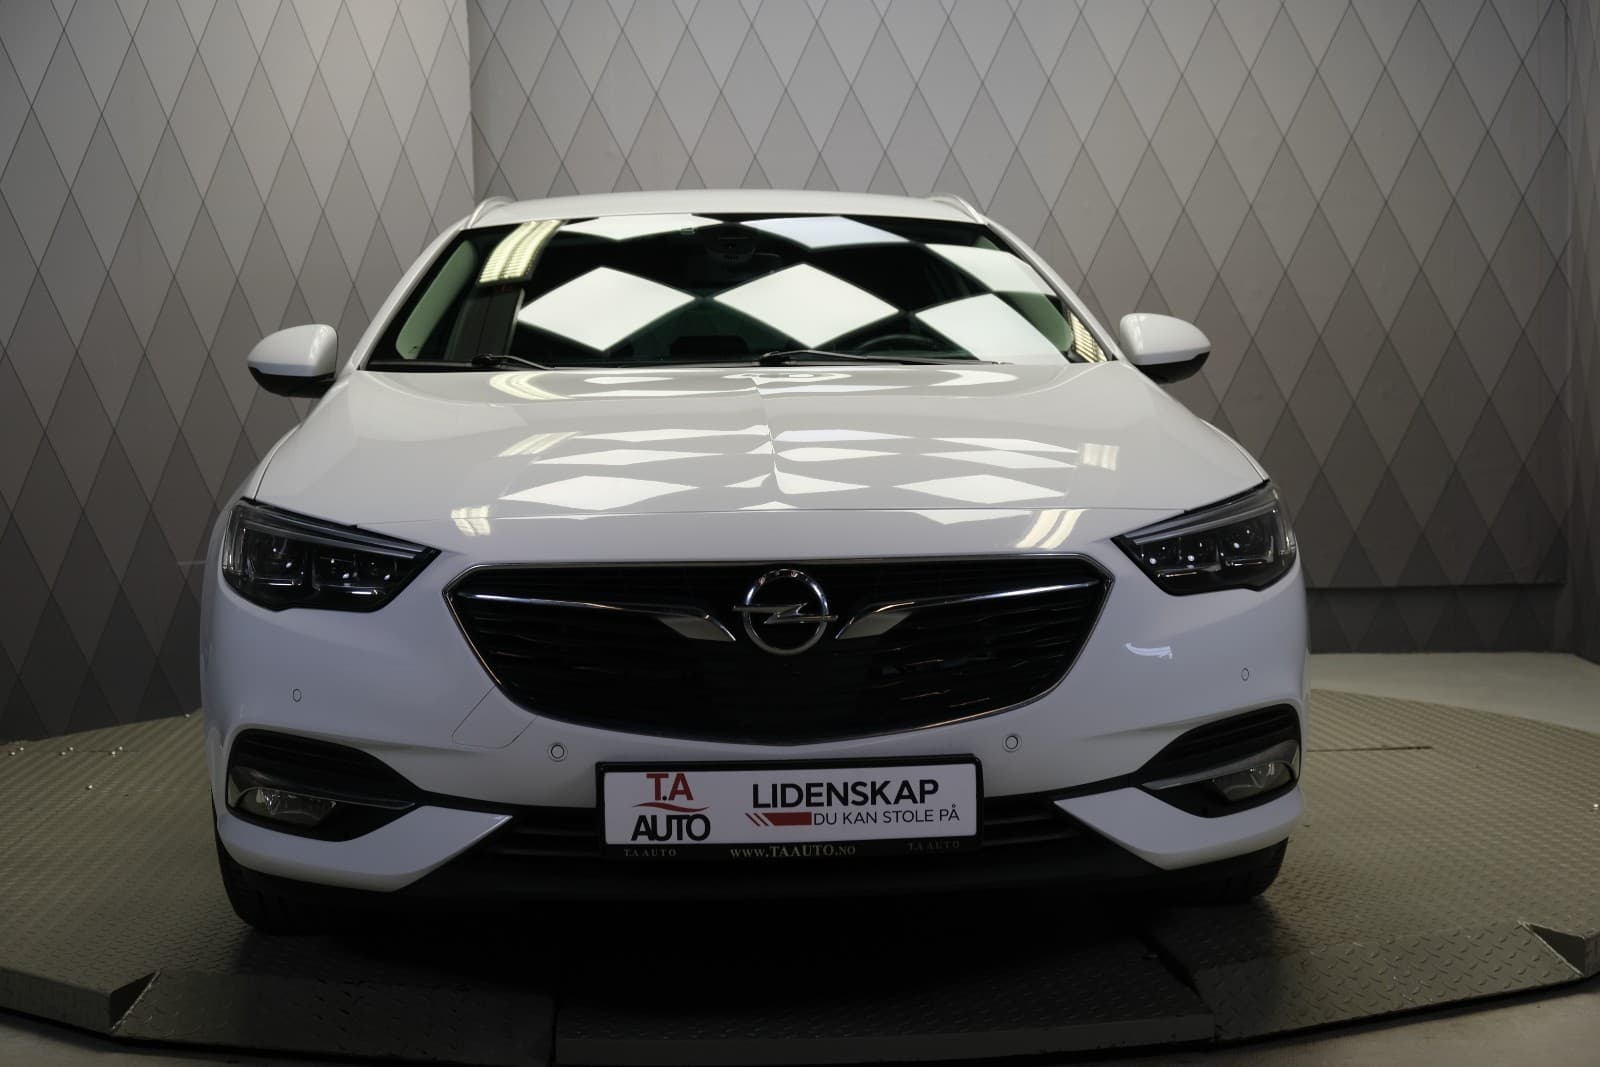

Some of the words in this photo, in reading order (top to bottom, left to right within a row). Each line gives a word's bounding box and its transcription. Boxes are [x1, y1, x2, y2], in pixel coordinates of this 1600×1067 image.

[646, 772, 694, 801] T.A
[752, 779, 939, 809] LIDENSKAP
[631, 813, 711, 842] AUTO
[814, 812, 839, 826] DU
[843, 811, 878, 825] KAN
[882, 809, 935, 824] STOLE
[939, 803, 960, 822] PÅ
